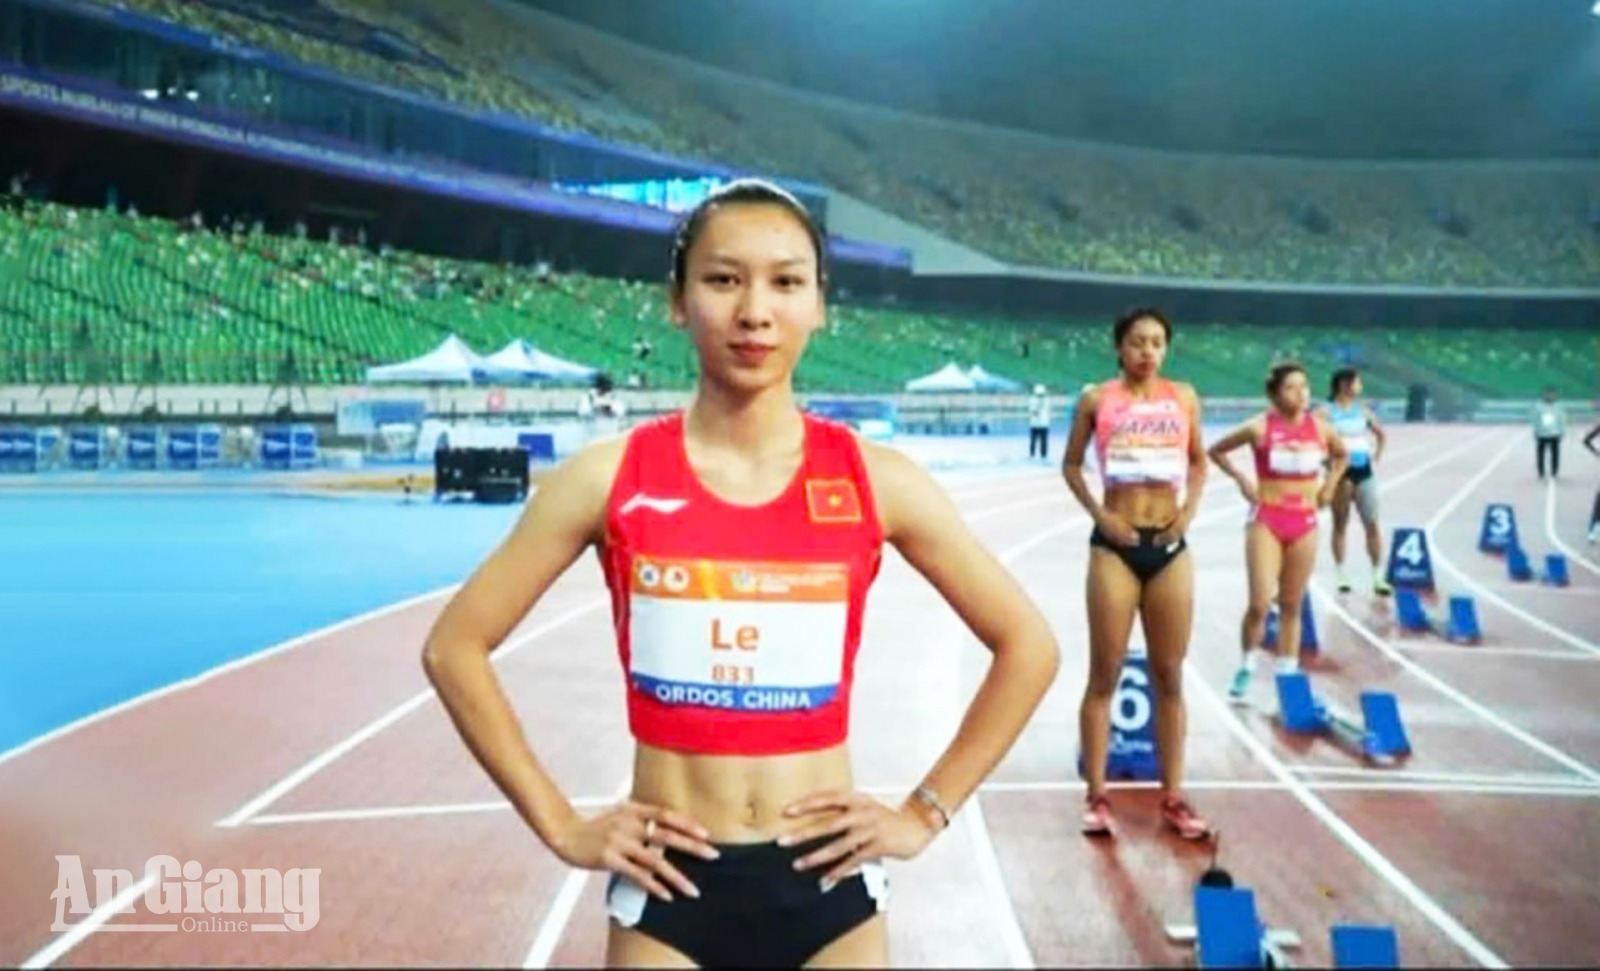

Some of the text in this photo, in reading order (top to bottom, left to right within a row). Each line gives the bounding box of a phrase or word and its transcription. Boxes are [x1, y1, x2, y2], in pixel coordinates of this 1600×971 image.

[1114, 419, 1180, 435] JAPAN
[1489, 508, 1510, 535] 3
[1397, 532, 1423, 566] 4
[711, 618, 759, 651] Le
[656, 684, 812, 710] ORDOS CHINA
[1110, 666, 1151, 730] 6
